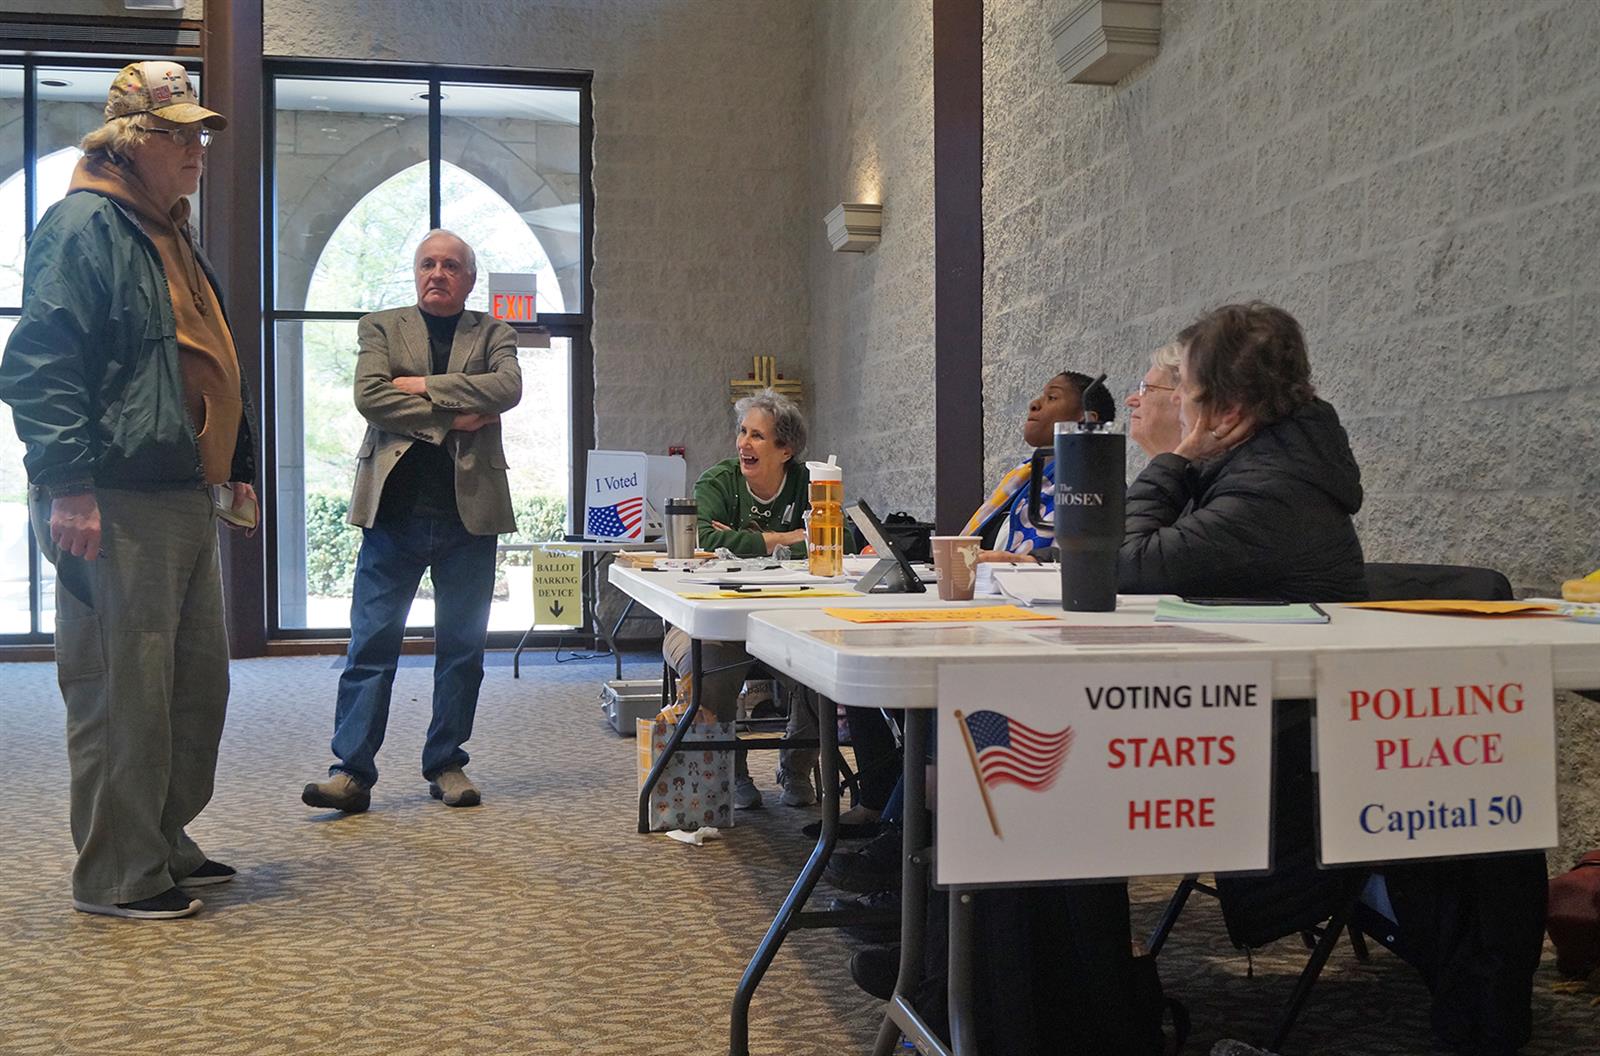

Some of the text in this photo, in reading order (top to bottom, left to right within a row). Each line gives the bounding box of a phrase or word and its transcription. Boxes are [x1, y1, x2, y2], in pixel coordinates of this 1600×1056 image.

[493, 294, 534, 320] EXIT
[596, 472, 638, 493] I Voted
[1060, 483, 1072, 491] The
[537, 564, 575, 572] BALLOT
[538, 589, 574, 597] DEVICE
[1085, 684, 1258, 710] VOTING LINE
[1349, 682, 1524, 721] POLLING
[1107, 735, 1236, 769] STARTS
[1376, 733, 1504, 770] PLACE
[1128, 797, 1216, 831] HERE
[1359, 794, 1523, 840] Capital 50
